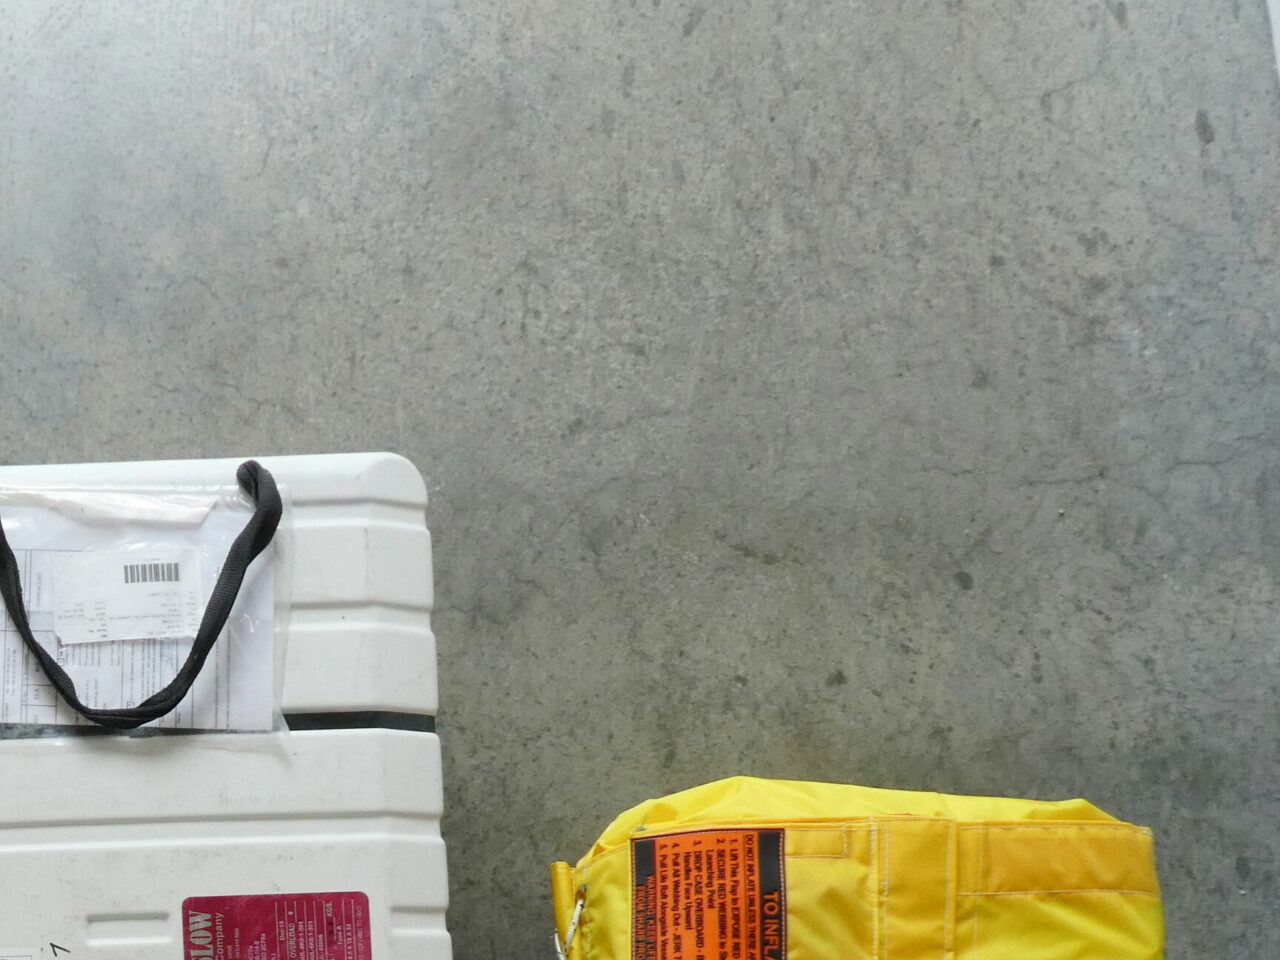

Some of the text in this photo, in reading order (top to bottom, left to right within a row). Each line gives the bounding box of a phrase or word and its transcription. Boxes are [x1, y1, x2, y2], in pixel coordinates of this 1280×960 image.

[746, 835, 752, 845] DO
[730, 863, 738, 877] This
[746, 863, 754, 891] INFLATE
[731, 897, 738, 905] to
[747, 894, 755, 923] UNLESS
[763, 891, 778, 915] TO
[731, 907, 739, 938] EXPOSE
[288, 922, 296, 957] OVERLOAD
[732, 941, 740, 958] RED
